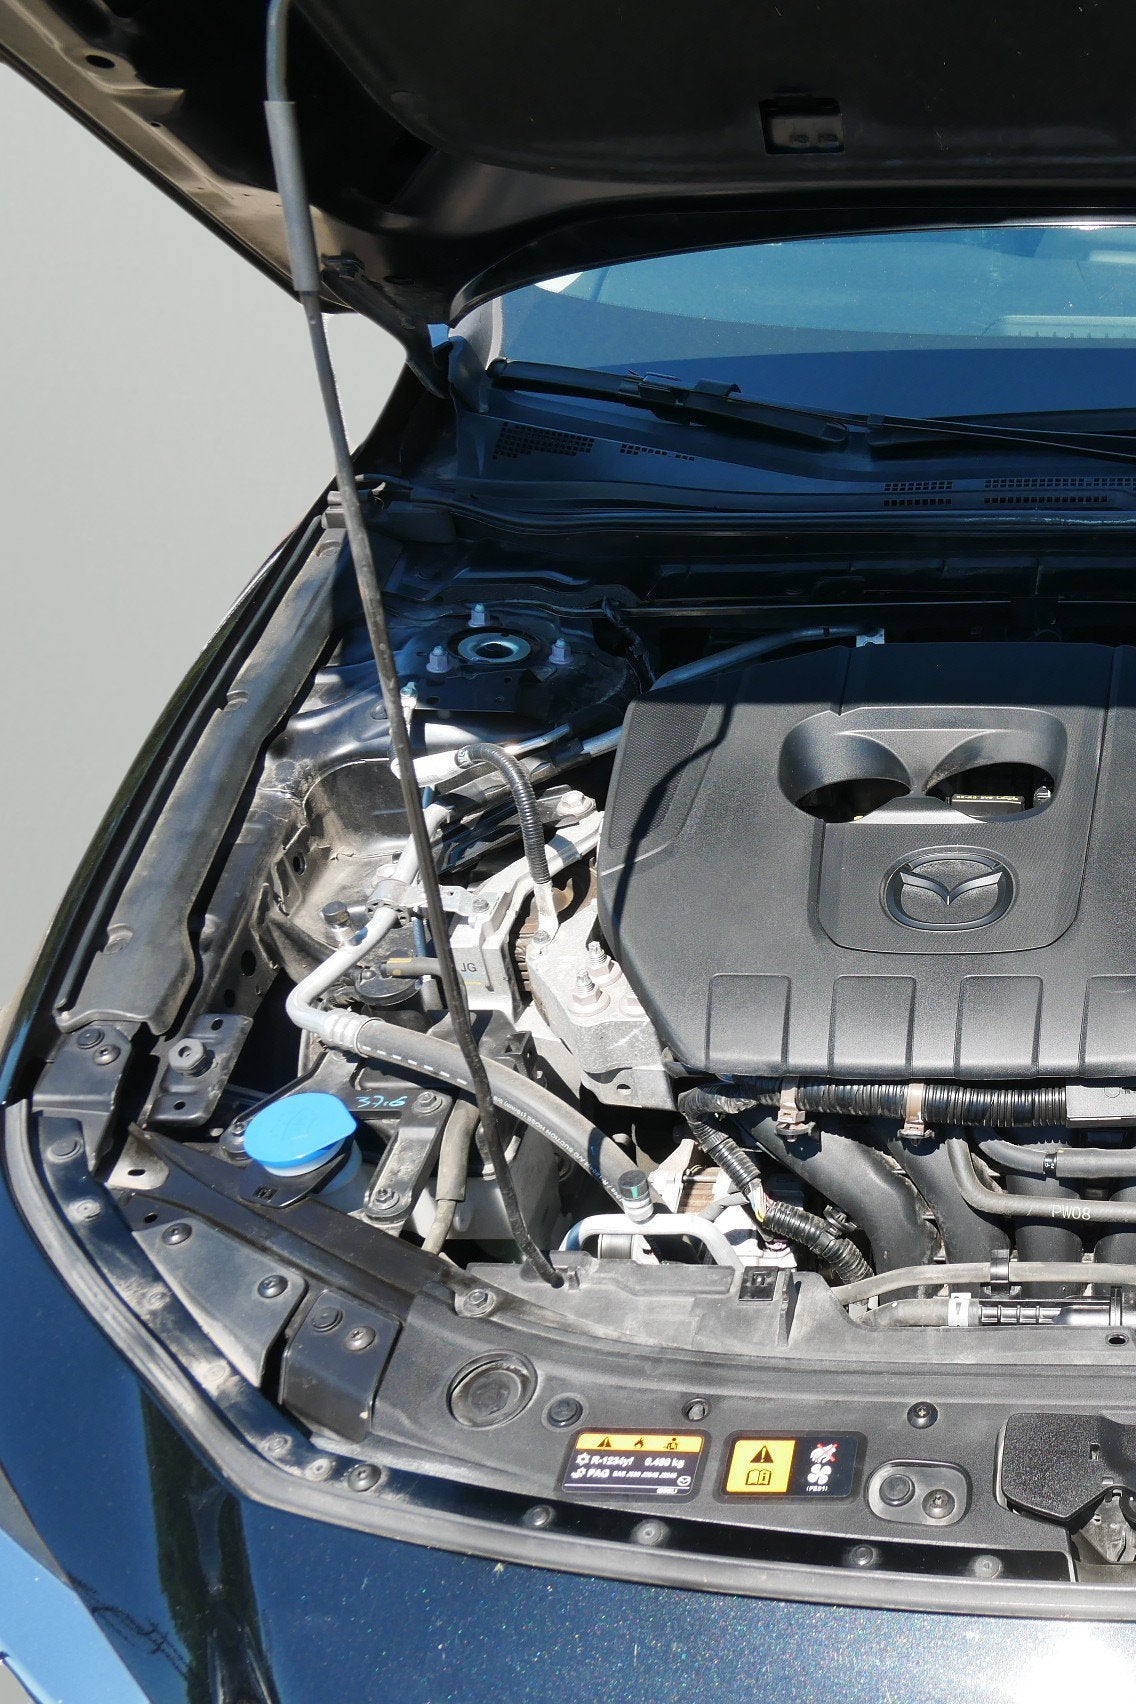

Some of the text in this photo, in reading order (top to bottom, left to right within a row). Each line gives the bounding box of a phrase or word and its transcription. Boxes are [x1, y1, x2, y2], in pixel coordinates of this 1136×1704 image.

[460, 962, 477, 972] JG
[1051, 1204, 1091, 1220] PW08
[671, 1458, 685, 1469] kg
[586, 1468, 611, 1478] PAG
